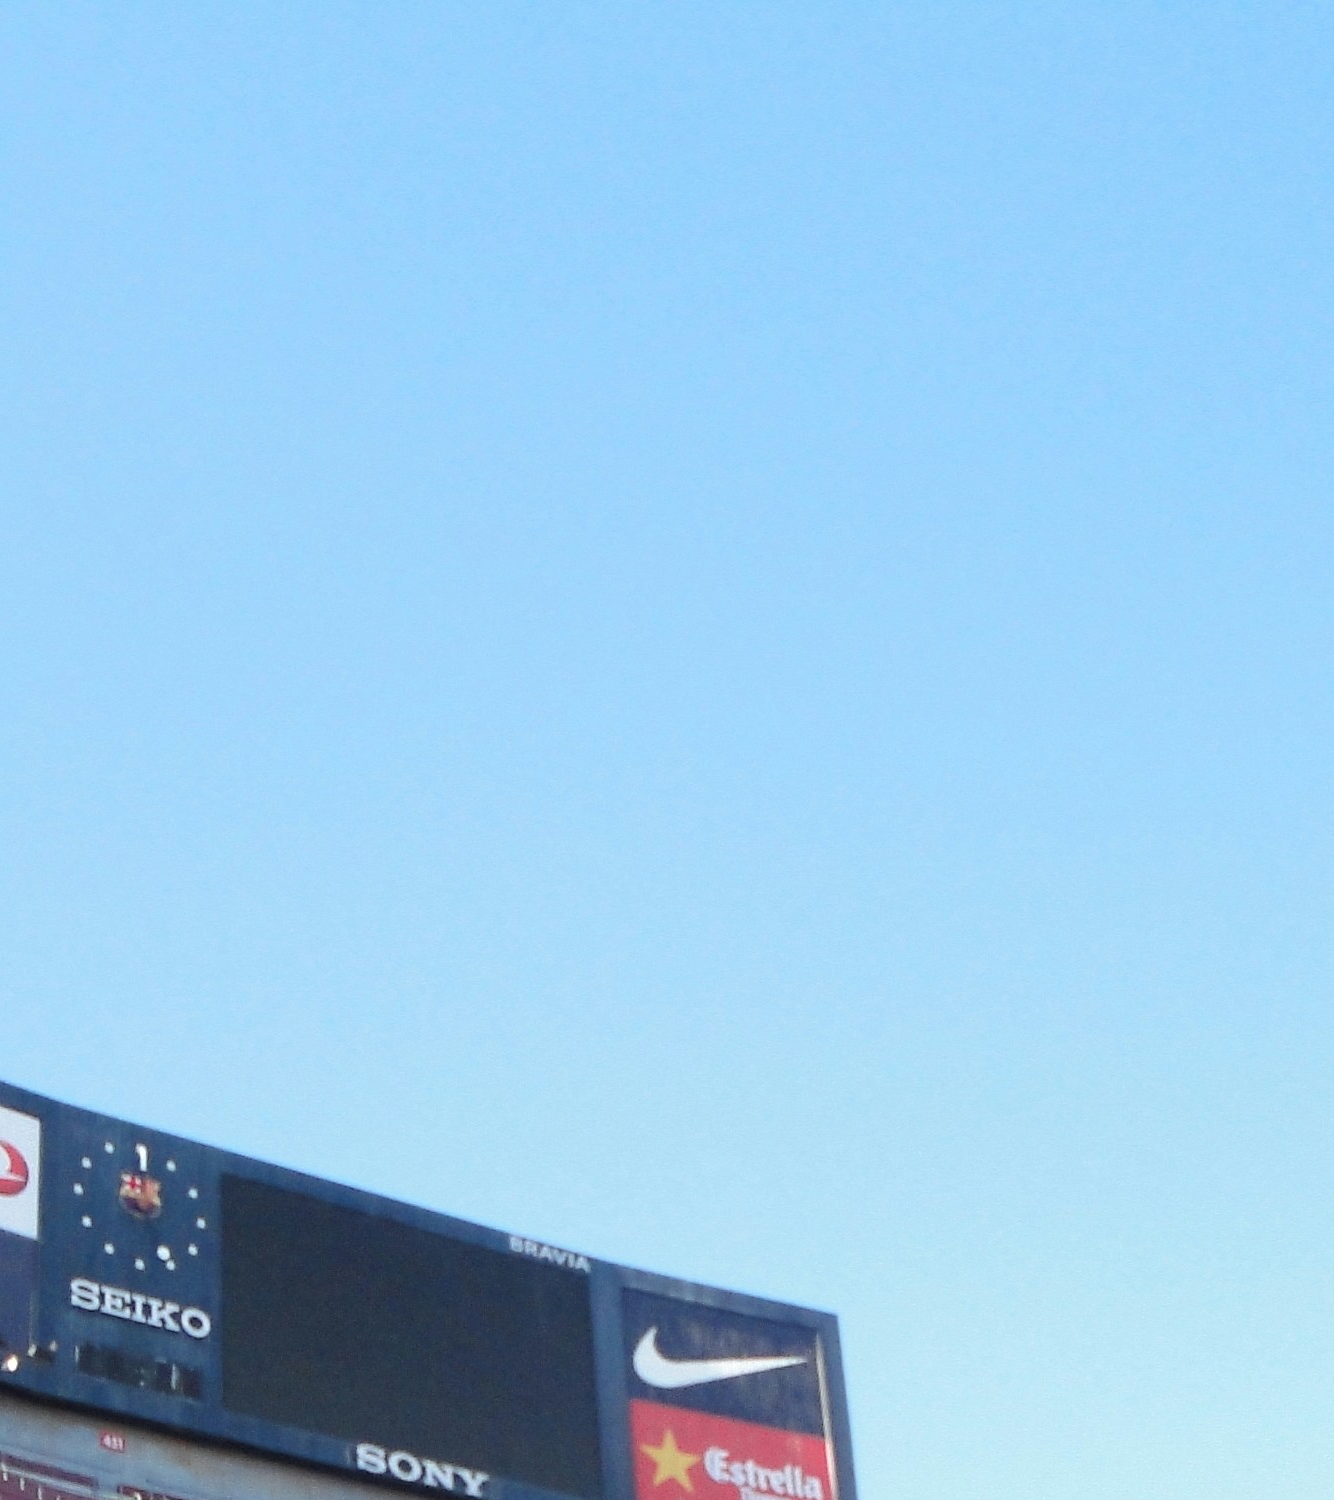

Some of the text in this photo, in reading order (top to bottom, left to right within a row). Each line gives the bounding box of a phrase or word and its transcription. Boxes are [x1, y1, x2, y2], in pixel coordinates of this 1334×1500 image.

[508, 1236, 591, 1274] BRAVIA
[69, 1276, 212, 1340] SEIKO
[356, 1442, 490, 1499] SONY
